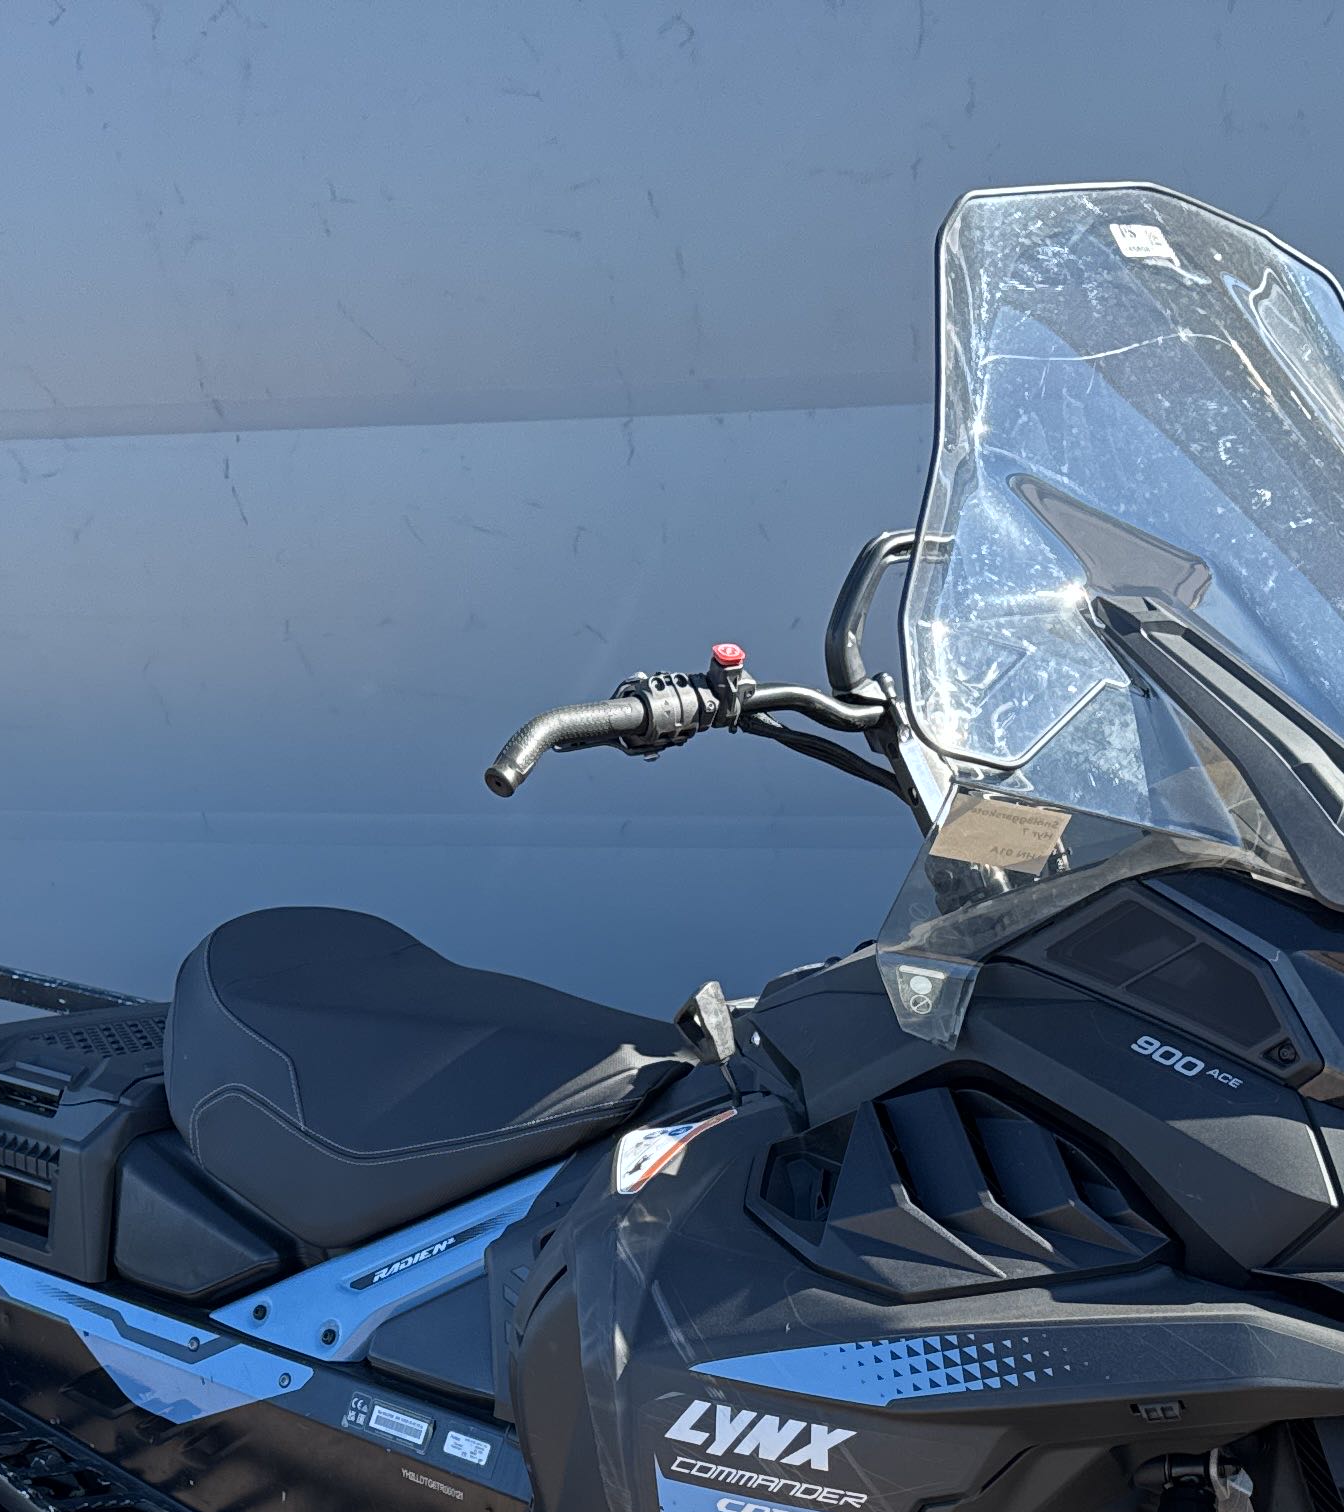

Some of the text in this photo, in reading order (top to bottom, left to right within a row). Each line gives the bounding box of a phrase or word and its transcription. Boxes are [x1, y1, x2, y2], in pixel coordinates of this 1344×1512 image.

[1130, 1035, 1244, 1089] 900 ACE
[664, 1399, 858, 1472] LYNX
[670, 1456, 868, 1509] COMMANDER
